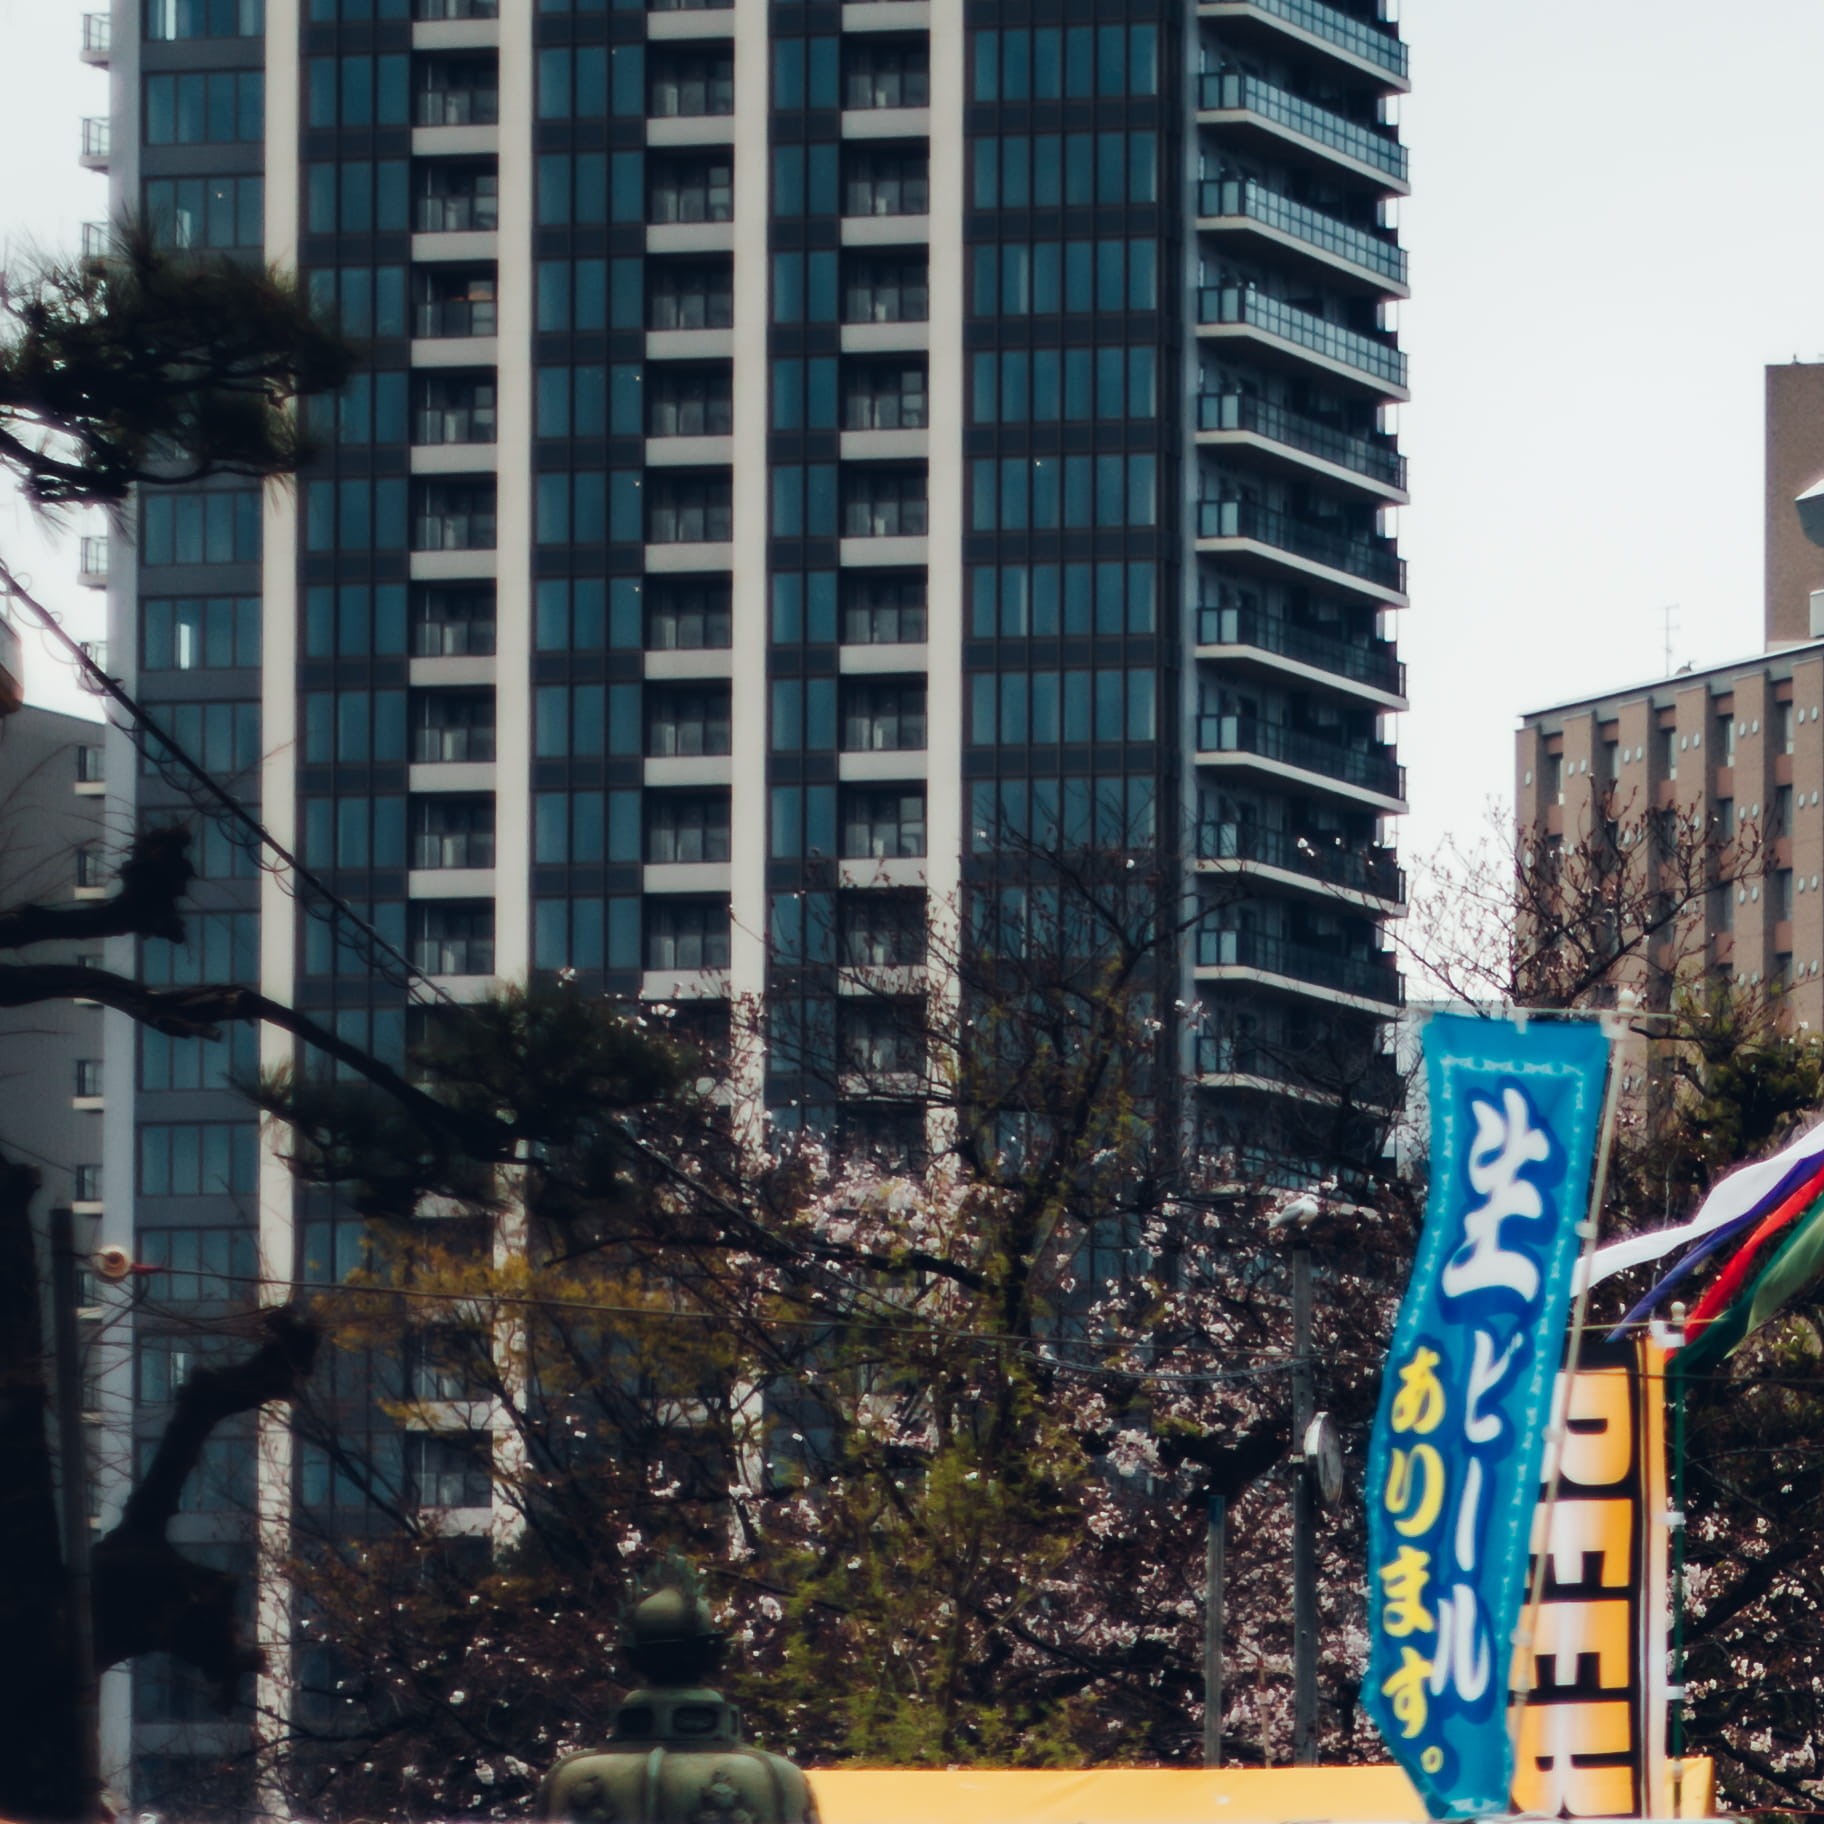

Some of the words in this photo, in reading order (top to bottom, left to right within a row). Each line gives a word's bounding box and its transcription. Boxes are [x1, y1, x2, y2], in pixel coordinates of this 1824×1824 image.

[1377, 1349, 1449, 1774] あります。
[1429, 1084, 1553, 1704] 生ビール
